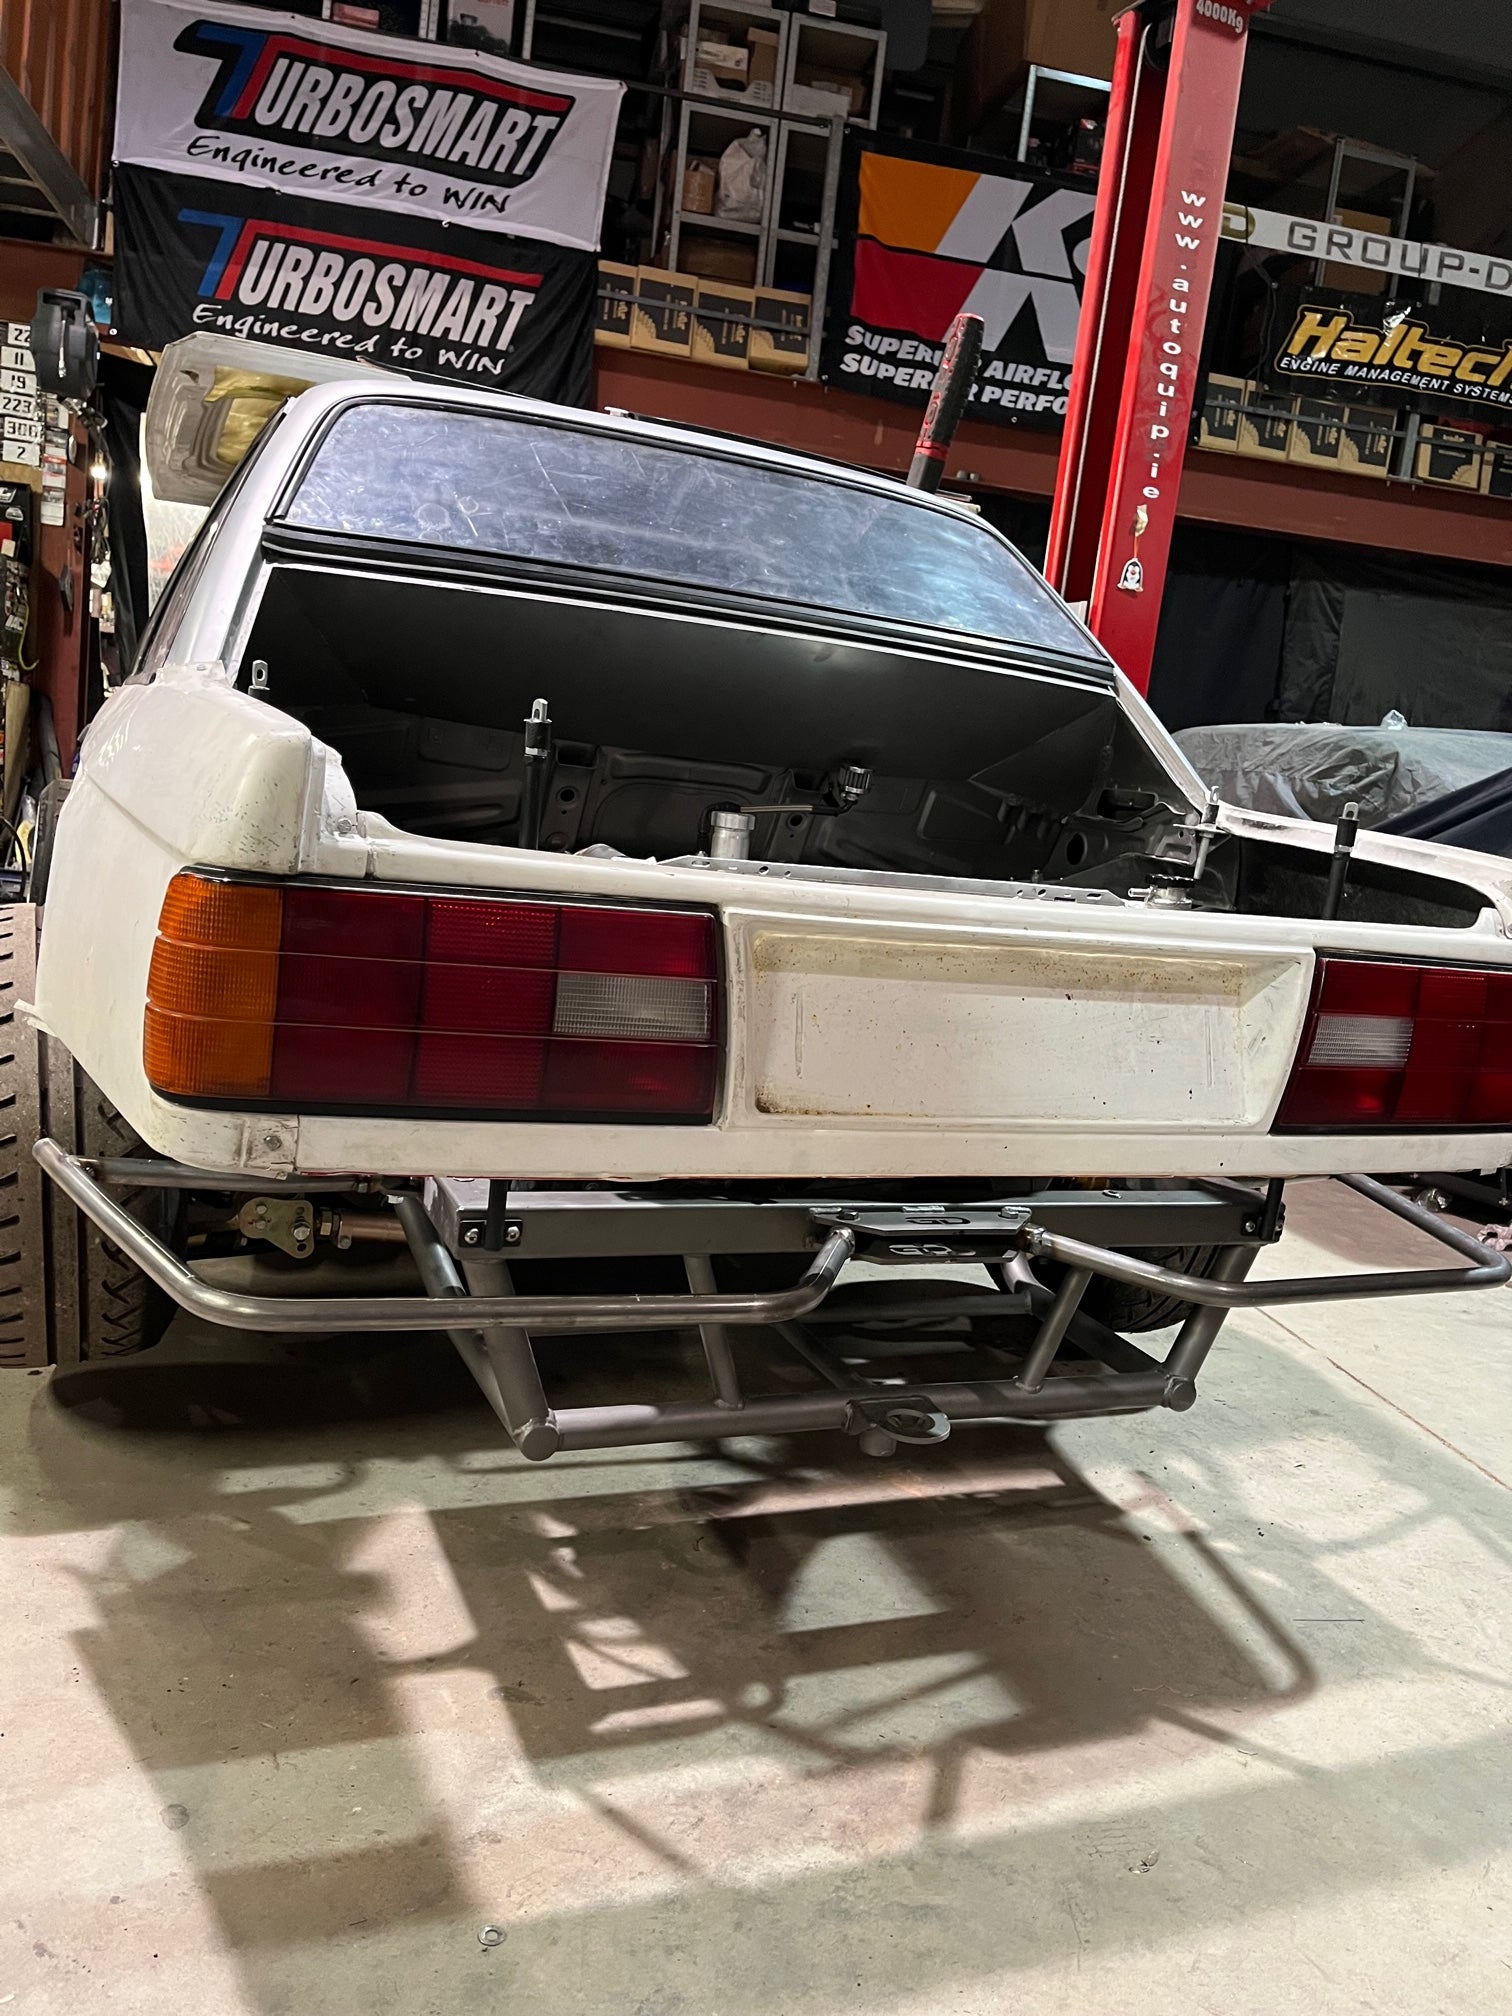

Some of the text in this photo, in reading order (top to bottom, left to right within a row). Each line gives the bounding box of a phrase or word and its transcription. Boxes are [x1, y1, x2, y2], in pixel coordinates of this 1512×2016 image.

[1196, 0, 1244, 33] 4000Kg
[195, 24, 572, 177] TURBOSMART
[186, 135, 512, 214] Engineered to WIN
[177, 208, 544, 352] TURBOSMART
[1287, 220, 1512, 292] GROUP-D
[192, 303, 506, 376] Engineered to WIN
[1279, 356, 1341, 375] ENGINE
[1343, 365, 1451, 392] MANAGEMENT
